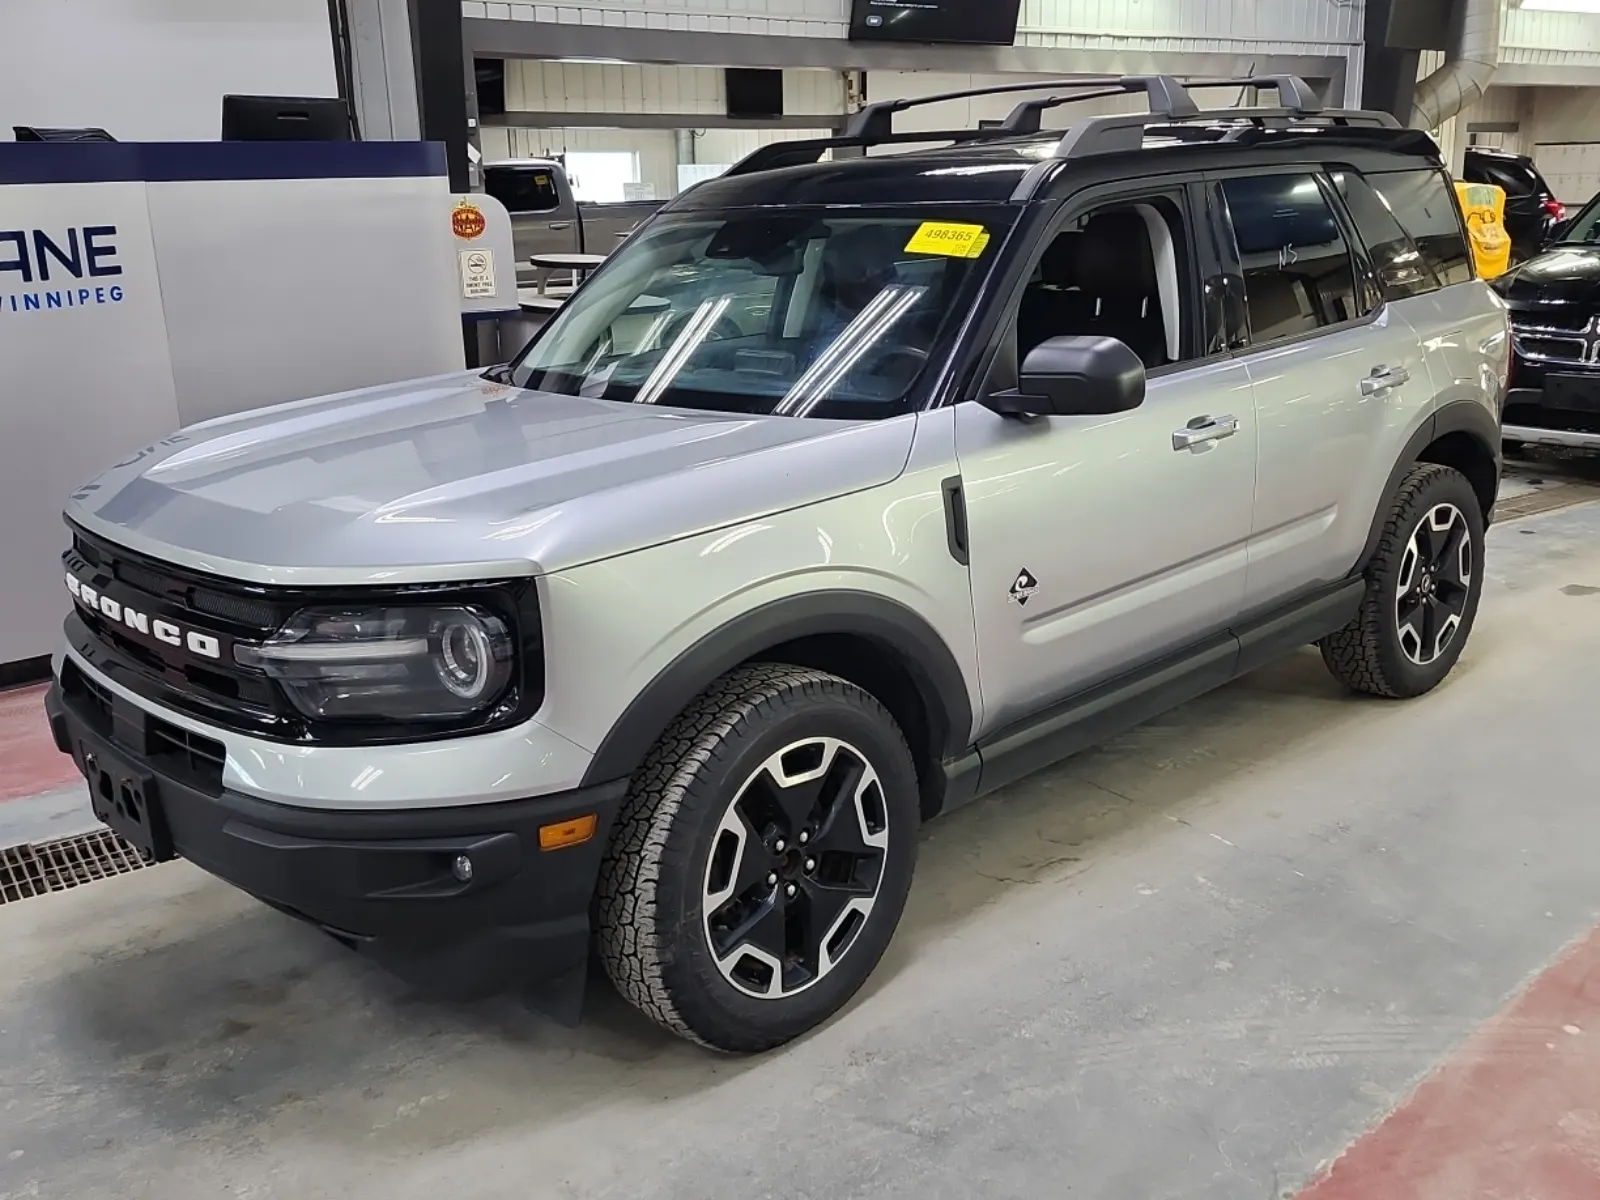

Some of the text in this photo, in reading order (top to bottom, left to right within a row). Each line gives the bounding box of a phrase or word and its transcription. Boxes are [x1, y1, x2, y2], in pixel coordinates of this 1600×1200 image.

[924, 228, 975, 242] 498365
[0, 286, 123, 313] INNIPEG
[66, 572, 221, 659] BRONCO
